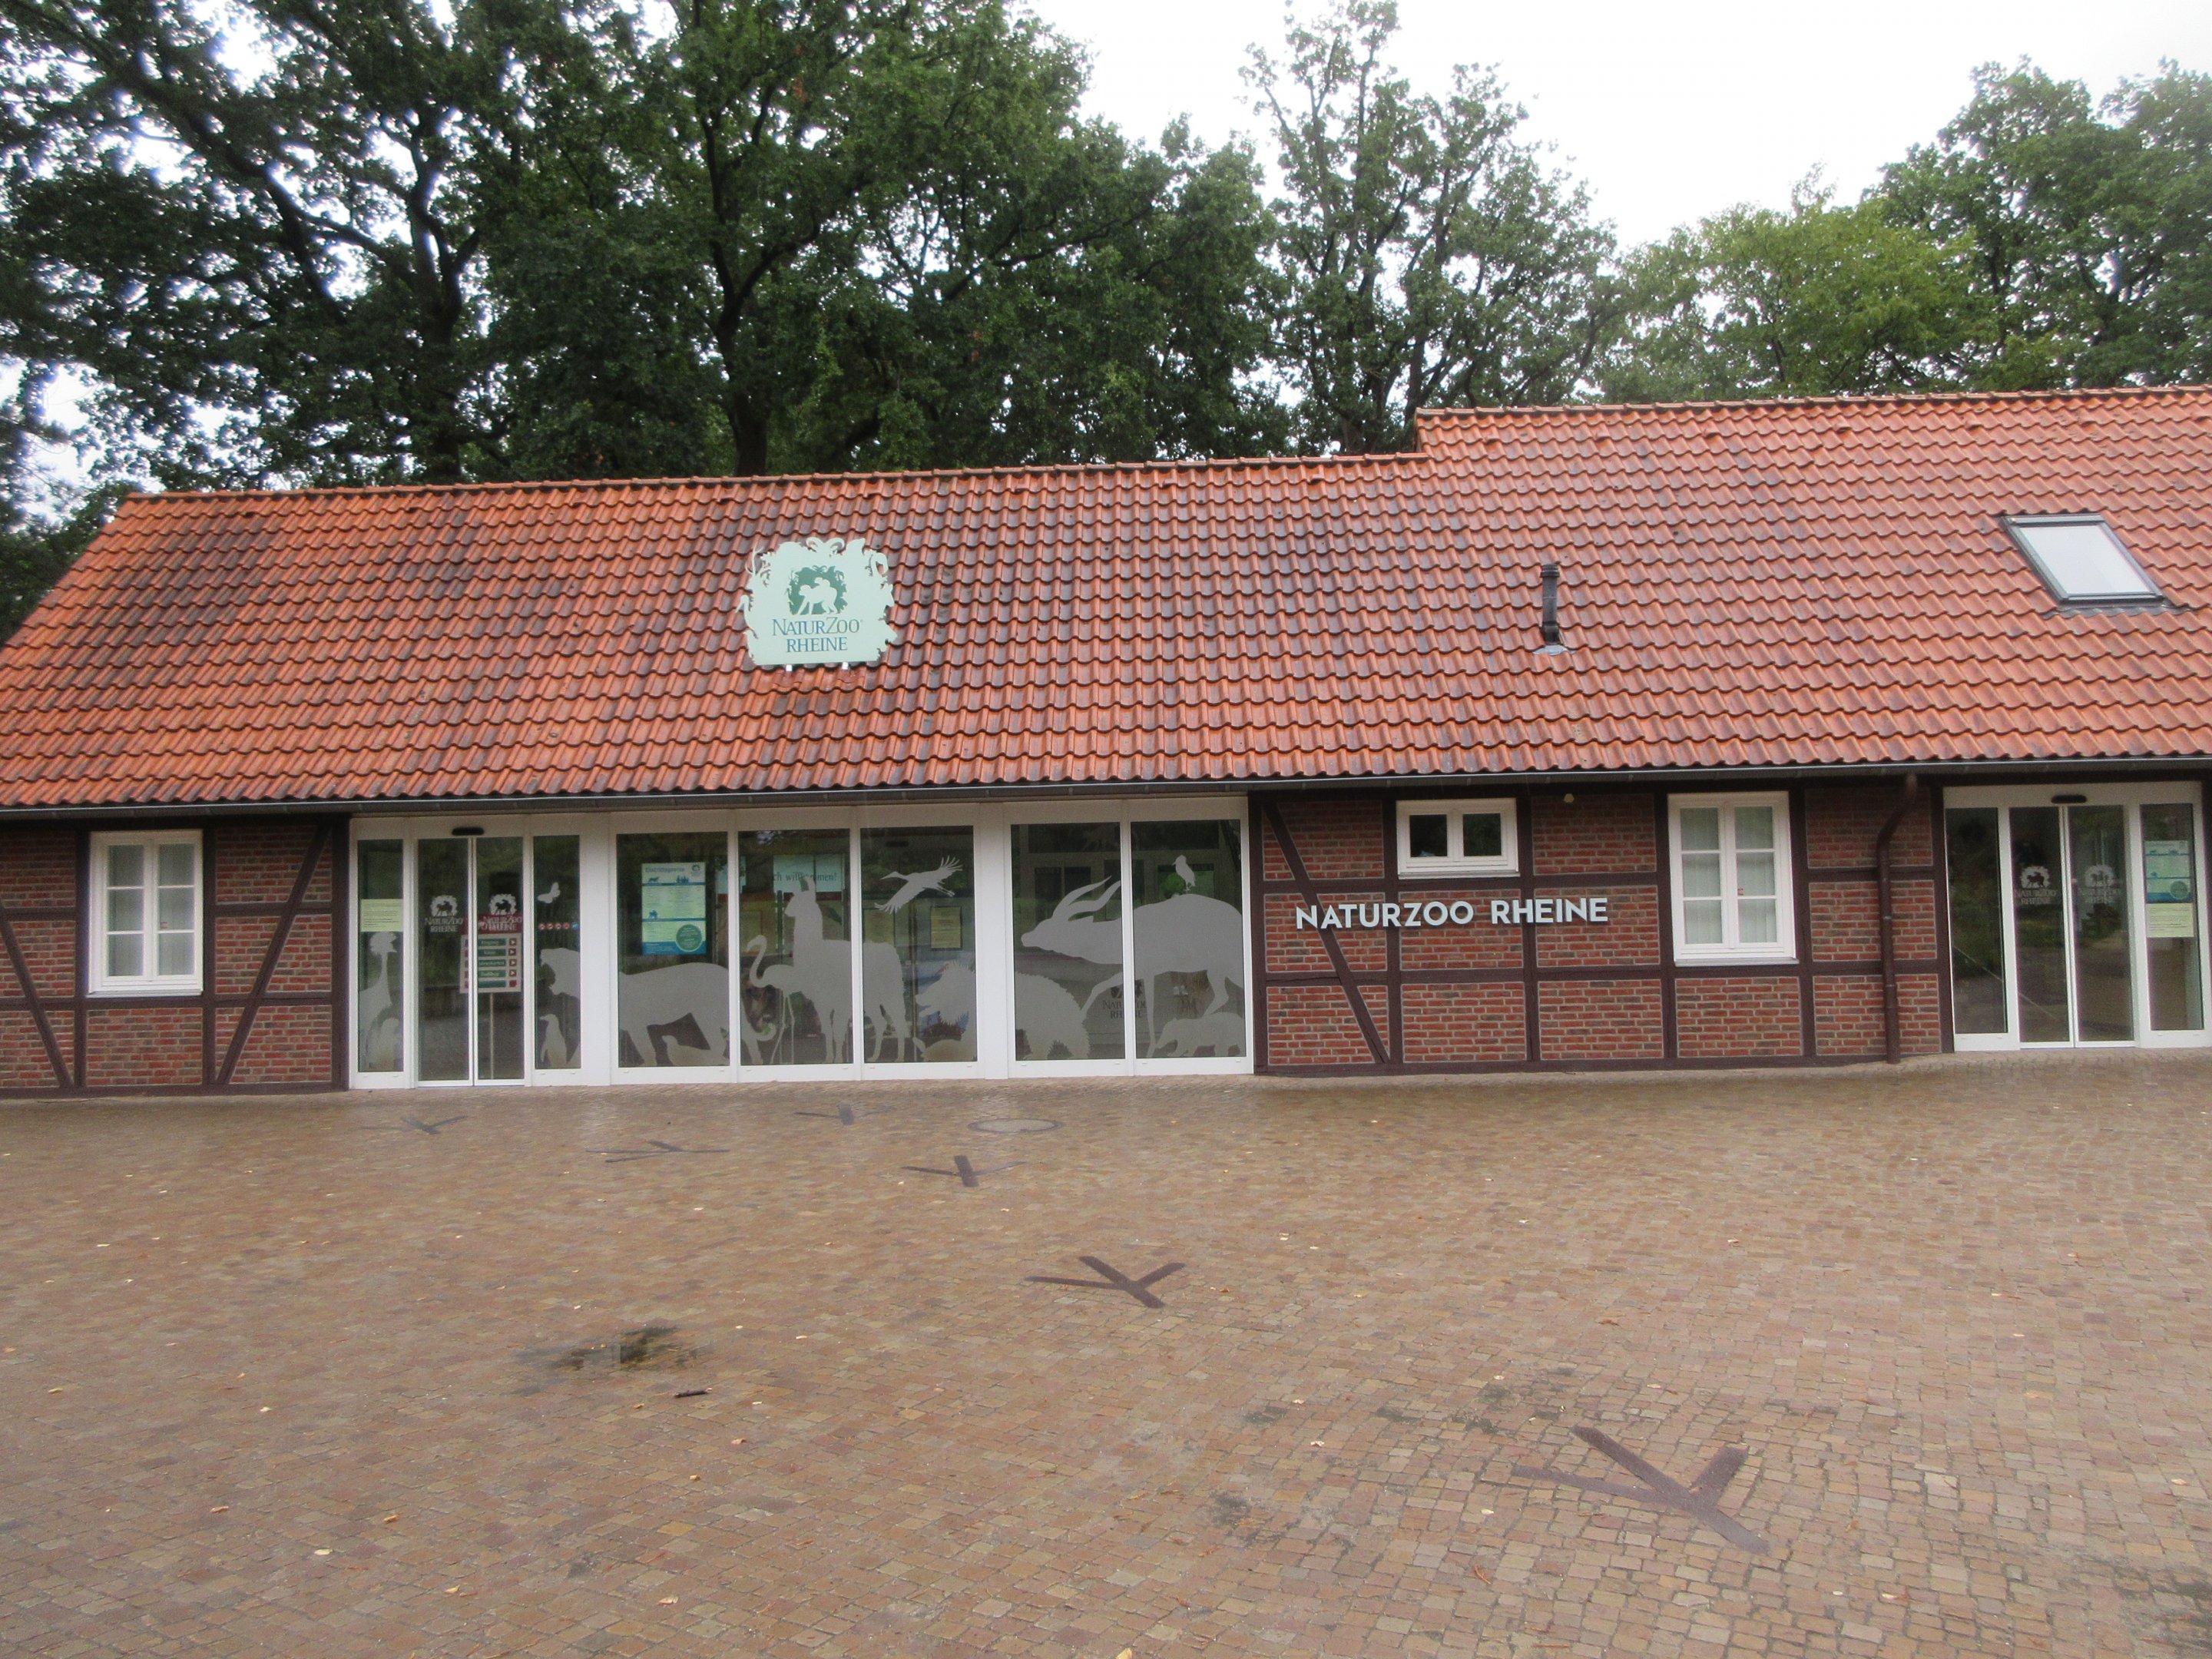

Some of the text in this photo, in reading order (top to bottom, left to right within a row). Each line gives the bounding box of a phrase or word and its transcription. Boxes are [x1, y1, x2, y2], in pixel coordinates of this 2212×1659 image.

[786, 637, 848, 653] RHEINE
[1296, 897, 1608, 929] NATURZOO RHEINE
